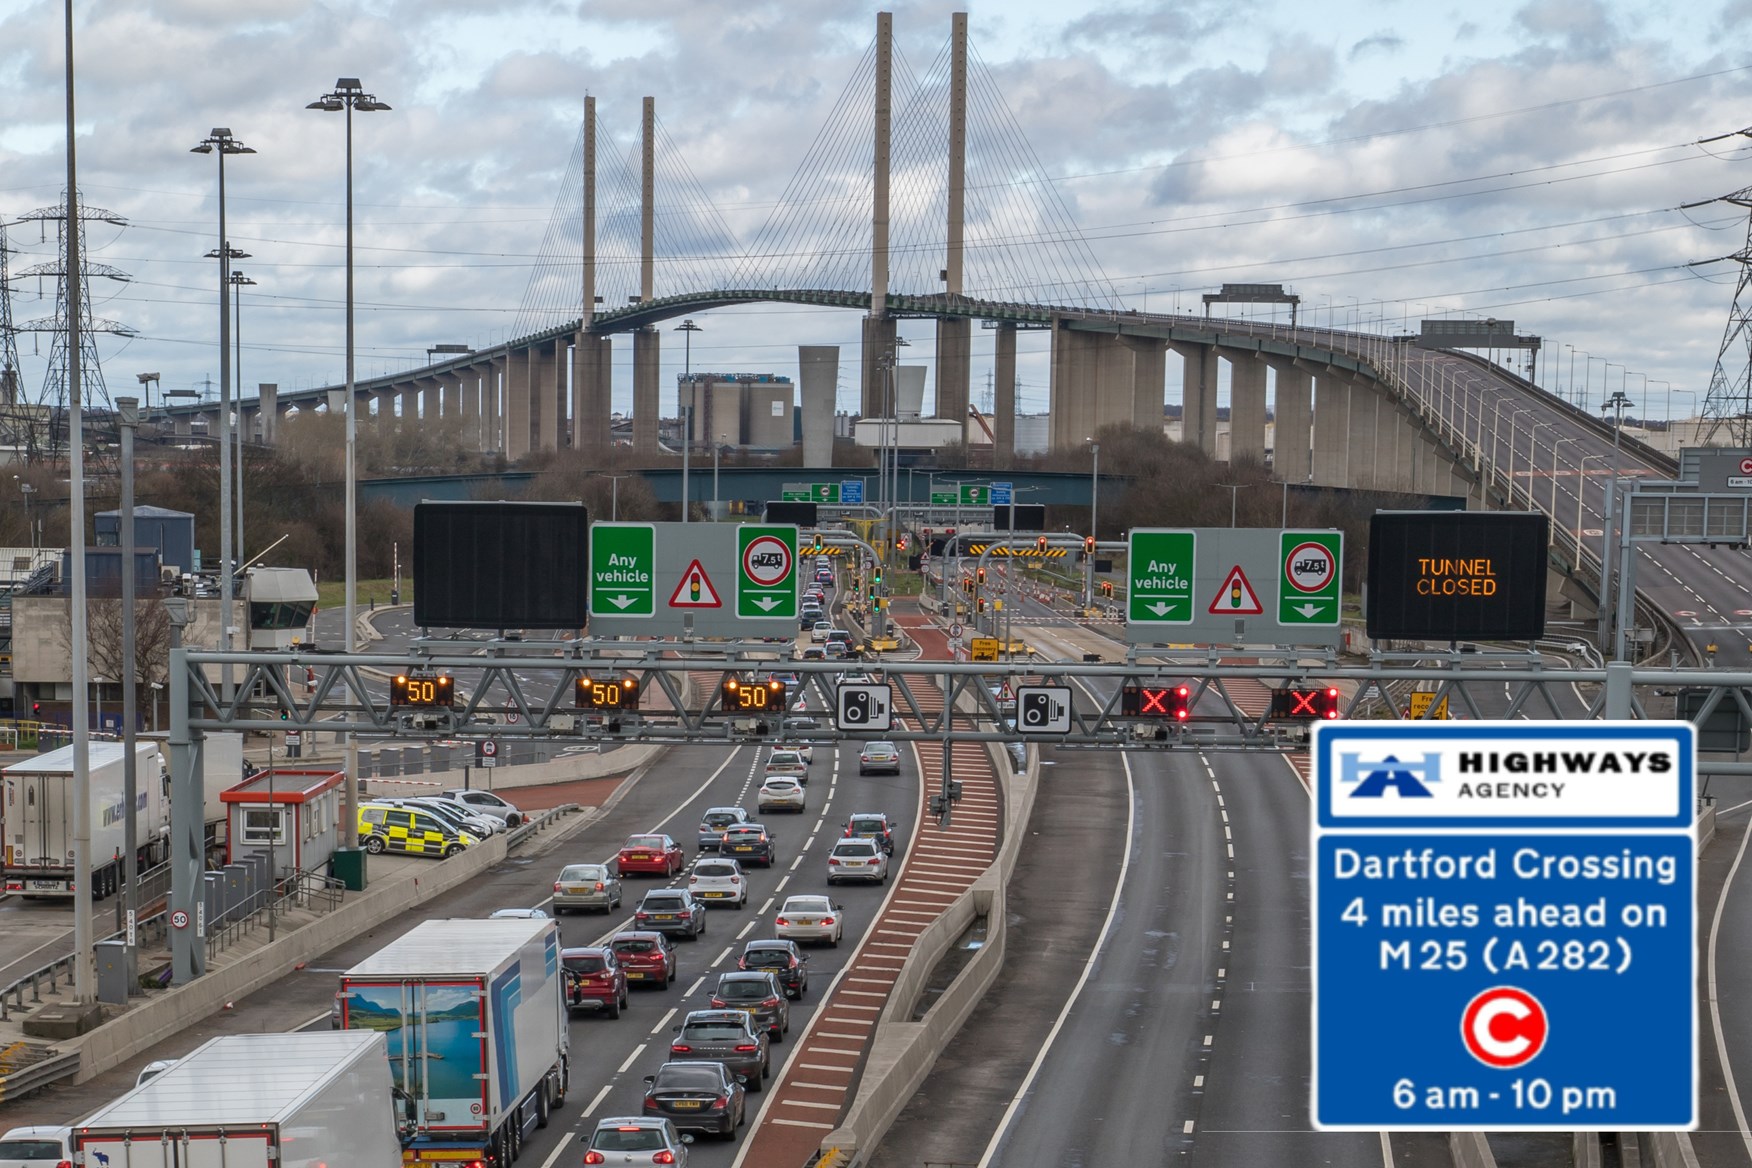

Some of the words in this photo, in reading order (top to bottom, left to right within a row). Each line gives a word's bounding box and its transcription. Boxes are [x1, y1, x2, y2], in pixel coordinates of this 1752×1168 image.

[608, 553, 637, 569] Any
[1147, 560, 1177, 576] Any
[1418, 558, 1496, 576] TUNNEL
[596, 569, 649, 583] vehicle
[1135, 576, 1189, 590] vehicle
[1416, 578, 1497, 596] CLOSED
[408, 682, 433, 701] 50
[593, 685, 619, 705] 50
[740, 687, 765, 707] 50
[174, 915, 186, 924] 50
